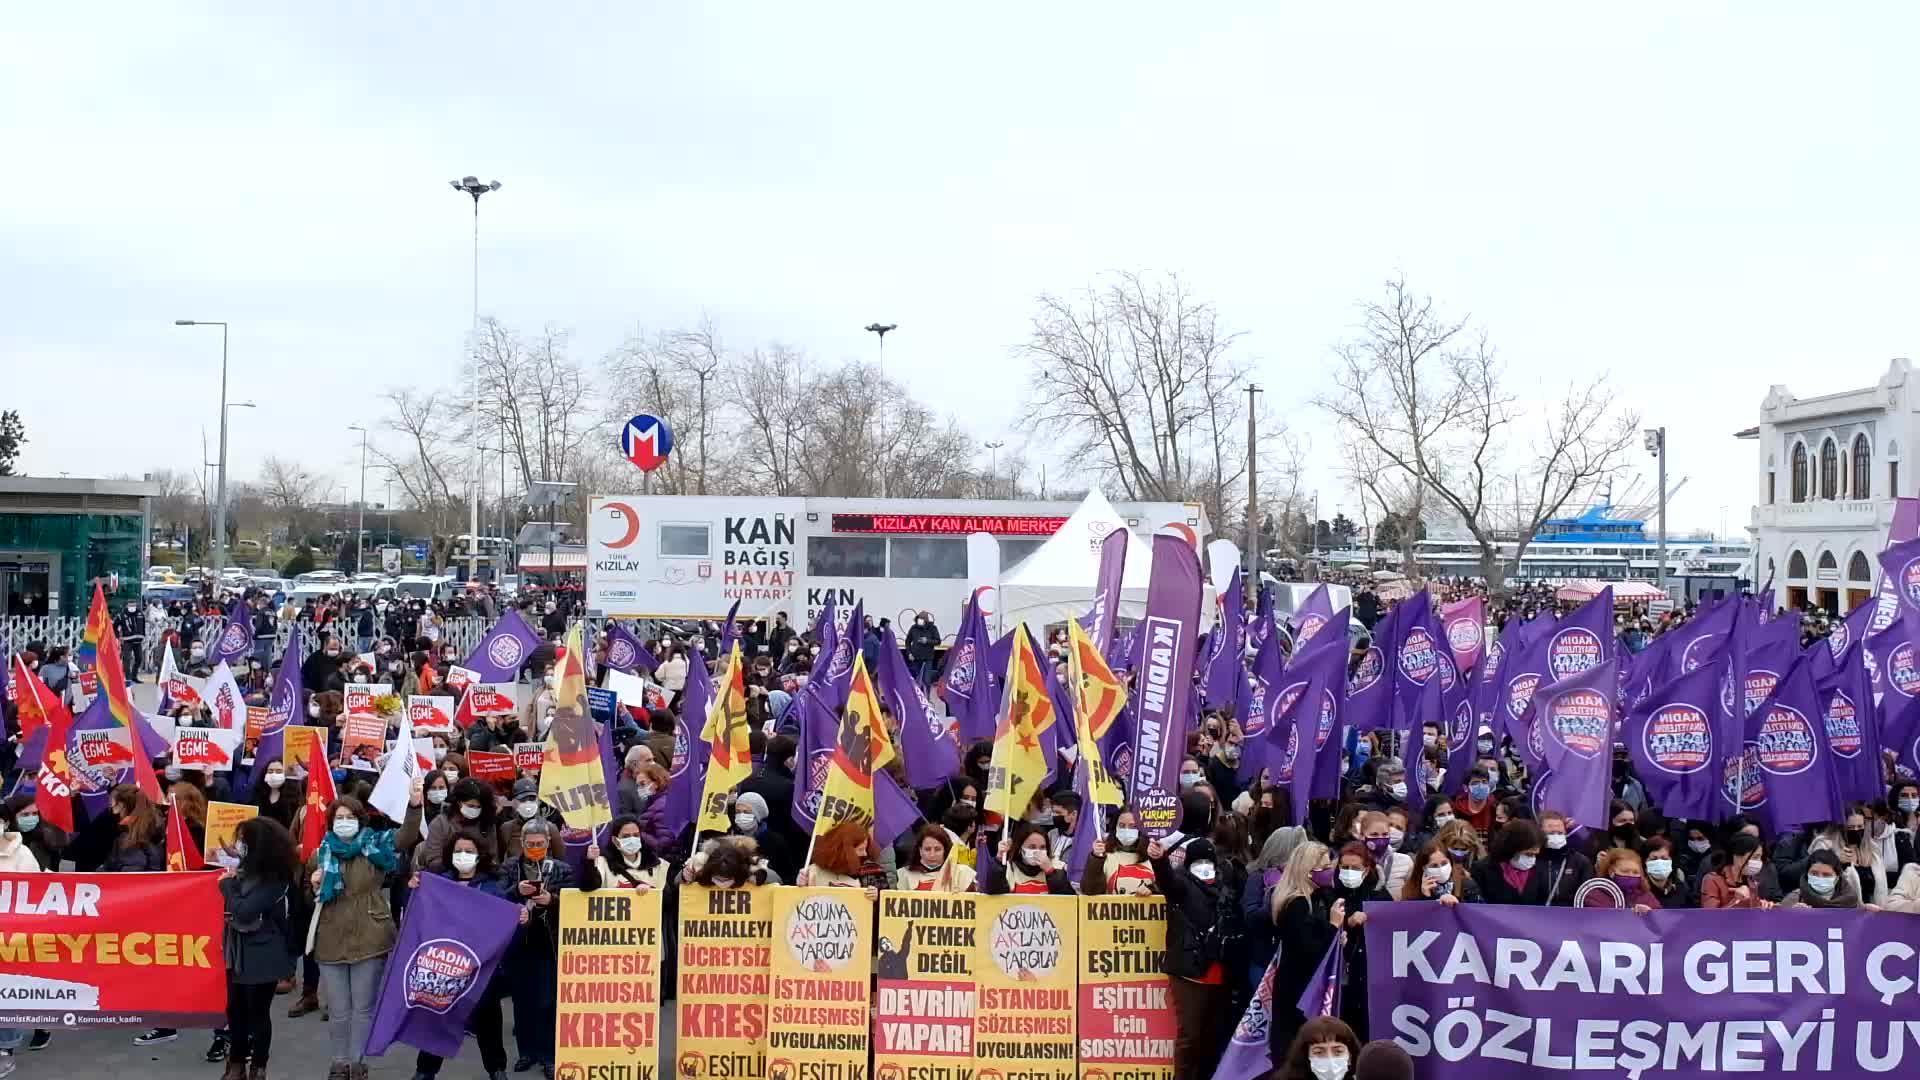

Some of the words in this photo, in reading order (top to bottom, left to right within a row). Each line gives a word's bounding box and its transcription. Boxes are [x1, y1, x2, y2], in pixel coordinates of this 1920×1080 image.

[629, 422, 659, 457] M
[725, 518, 794, 545] KAN
[873, 518, 928, 530] KIZILAY
[931, 519, 961, 531] KAN
[963, 520, 1004, 531] ALMA
[596, 560, 639, 571] KIZILAY
[725, 570, 794, 586] HAYAT
[38, 760, 70, 797] TKP
[588, 896, 631, 921] HER
[709, 890, 752, 915] HER
[797, 900, 852, 921] KORUMA
[885, 898, 976, 920] KADINLAR
[999, 908, 1056, 931] KORUMA
[562, 928, 656, 946] MAHALLEYE
[915, 926, 976, 947] YEMEK
[1113, 926, 1145, 947] için
[427, 946, 471, 969] KADIN
[562, 951, 655, 977] ÜCRETSİZ,
[918, 950, 972, 976] DEĞİL,
[1392, 930, 1664, 995] KARARI
[1683, 928, 1846, 995] GERİ
[1866, 942, 1920, 1006] Ç
[560, 982, 656, 1004] KAMUSAL
[775, 975, 866, 1002] İSTANBUL
[979, 984, 1072, 1011] İSTANBUL
[1093, 984, 1168, 1014] EŞİTLİK
[880, 986, 975, 1018] DEVRİM
[773, 1004, 866, 1028] SÖZLEŞMESİ
[978, 1013, 1072, 1038] SÖZLEŞMESİ
[1113, 1015, 1147, 1038] için
[560, 1012, 655, 1055] KREŞ!
[770, 1032, 867, 1051] UYGULANSIN!
[883, 1022, 971, 1053] YAPAR!
[1391, 996, 1835, 1080] SÖZLEŞMEYİ
[976, 1042, 1073, 1059] UYGULANSIN!
[1081, 1036, 1175, 1058] SOSYALİZM
